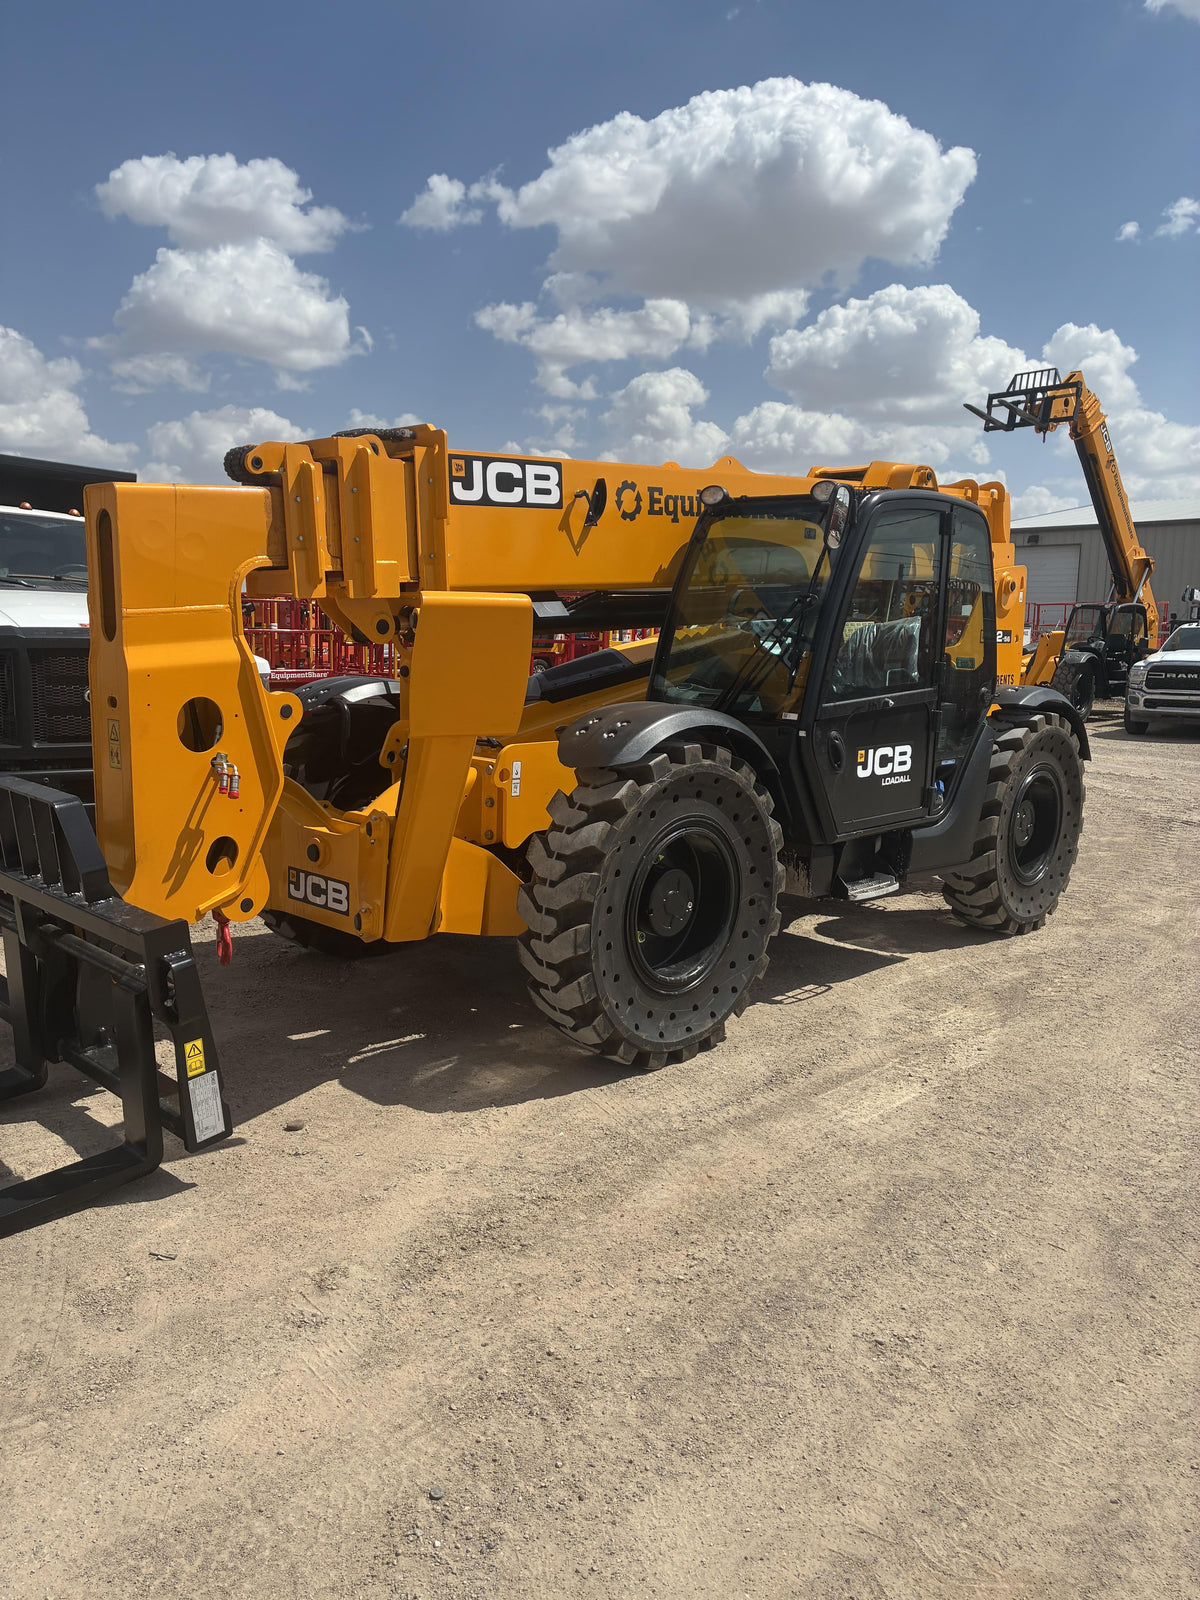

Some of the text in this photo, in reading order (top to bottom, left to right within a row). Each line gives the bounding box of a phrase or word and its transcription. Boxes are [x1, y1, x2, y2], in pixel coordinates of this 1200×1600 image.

[1101, 424, 1112, 453] JCB
[452, 460, 561, 505] JCB
[647, 486, 703, 523] Equi
[270, 671, 328, 679] EquipmentShare
[856, 744, 912, 778] JCB
[881, 775, 911, 786] LOADALL
[289, 872, 349, 912] JCB
